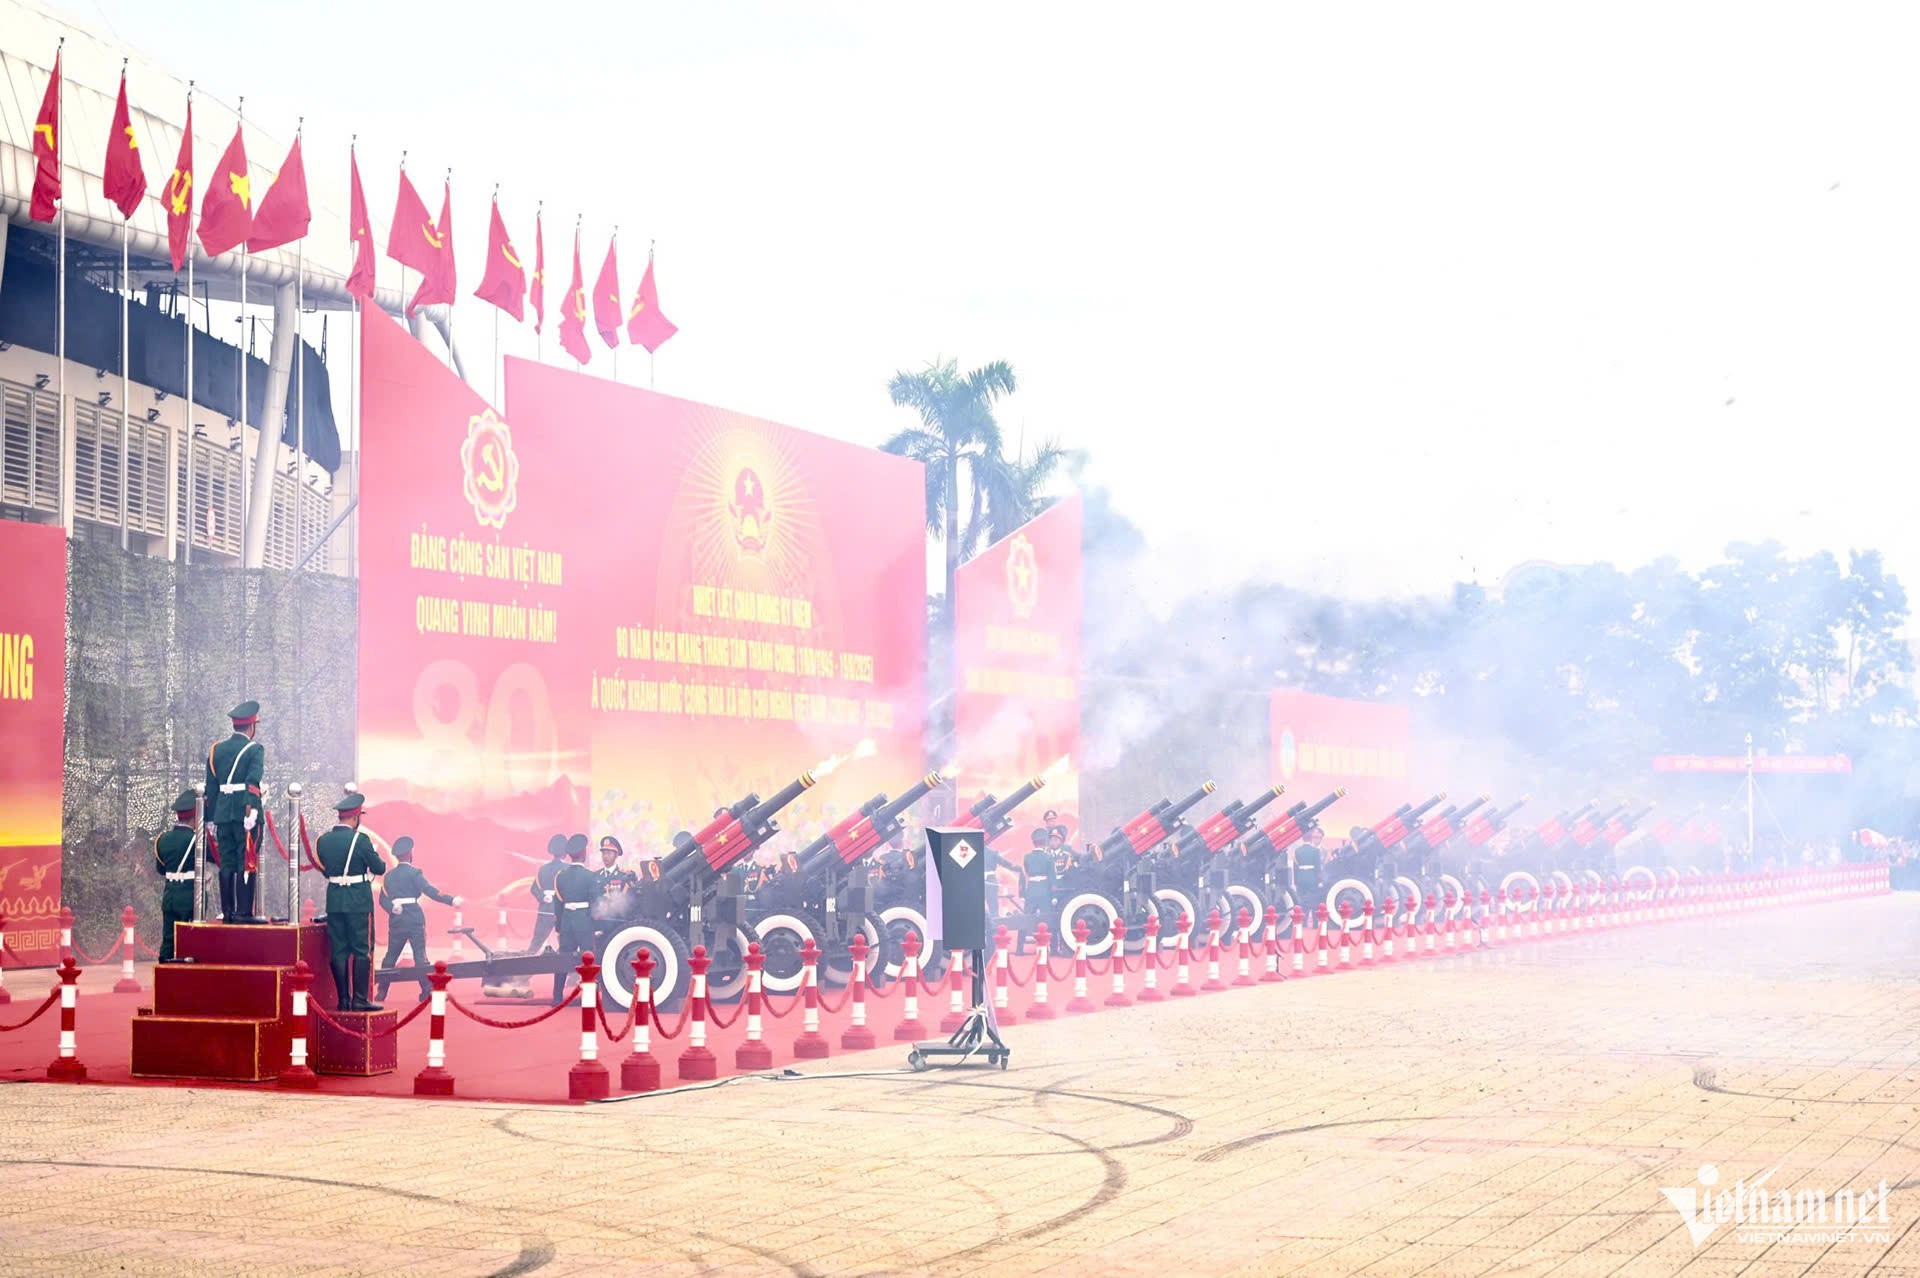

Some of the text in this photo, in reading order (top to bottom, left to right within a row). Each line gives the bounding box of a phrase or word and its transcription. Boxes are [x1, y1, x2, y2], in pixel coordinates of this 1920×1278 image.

[410, 521, 563, 589] ĐẢNG CỘNG SẢN VIỆT NAM
[416, 595, 557, 644] QUANG VINH MUÔN NĂM!
[616, 626, 628, 658] 80
[630, 622, 651, 660] NĂM
[653, 624, 676, 662] CÁCH
[0, 634, 34, 700] NG
[600, 668, 627, 712] QUỐC
[628, 673, 659, 712] KHÁNH
